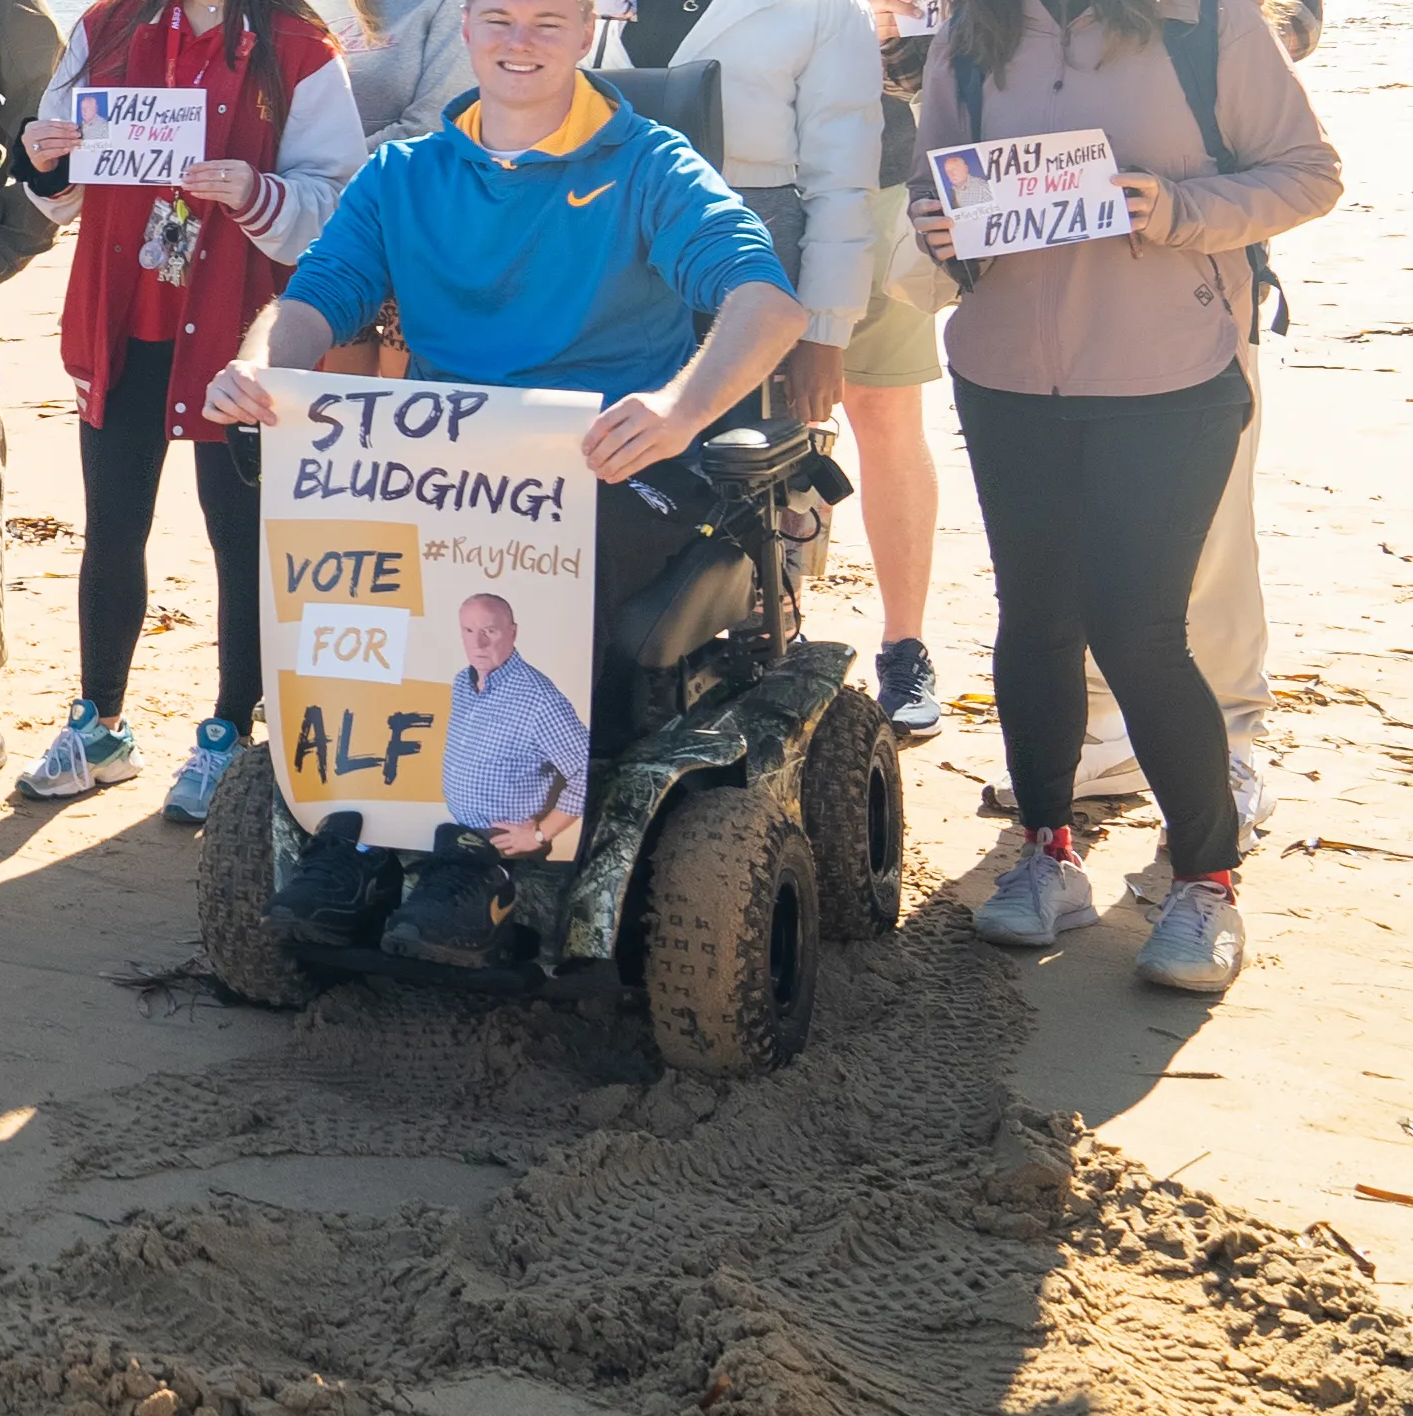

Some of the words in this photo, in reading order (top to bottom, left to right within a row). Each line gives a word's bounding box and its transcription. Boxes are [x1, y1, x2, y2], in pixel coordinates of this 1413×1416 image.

[107, 93, 158, 125] RAY
[154, 105, 203, 125] MEAGHER
[128, 124, 146, 141] TO
[93, 149, 174, 185] BONZA
[985, 142, 1043, 183] RAY
[1045, 143, 1108, 172] MEAGHER
[1017, 176, 1038, 197] TO
[984, 197, 1090, 247] BONZA
[1097, 199, 1115, 230] !!
[307, 389, 490, 453] STOP
[293, 457, 566, 523] BLUDGING!
[285, 550, 404, 598] VOTE
[423, 535, 582, 580] #Ray4Gold
[312, 625, 391, 671] FOR
[293, 703, 435, 786] ALF
